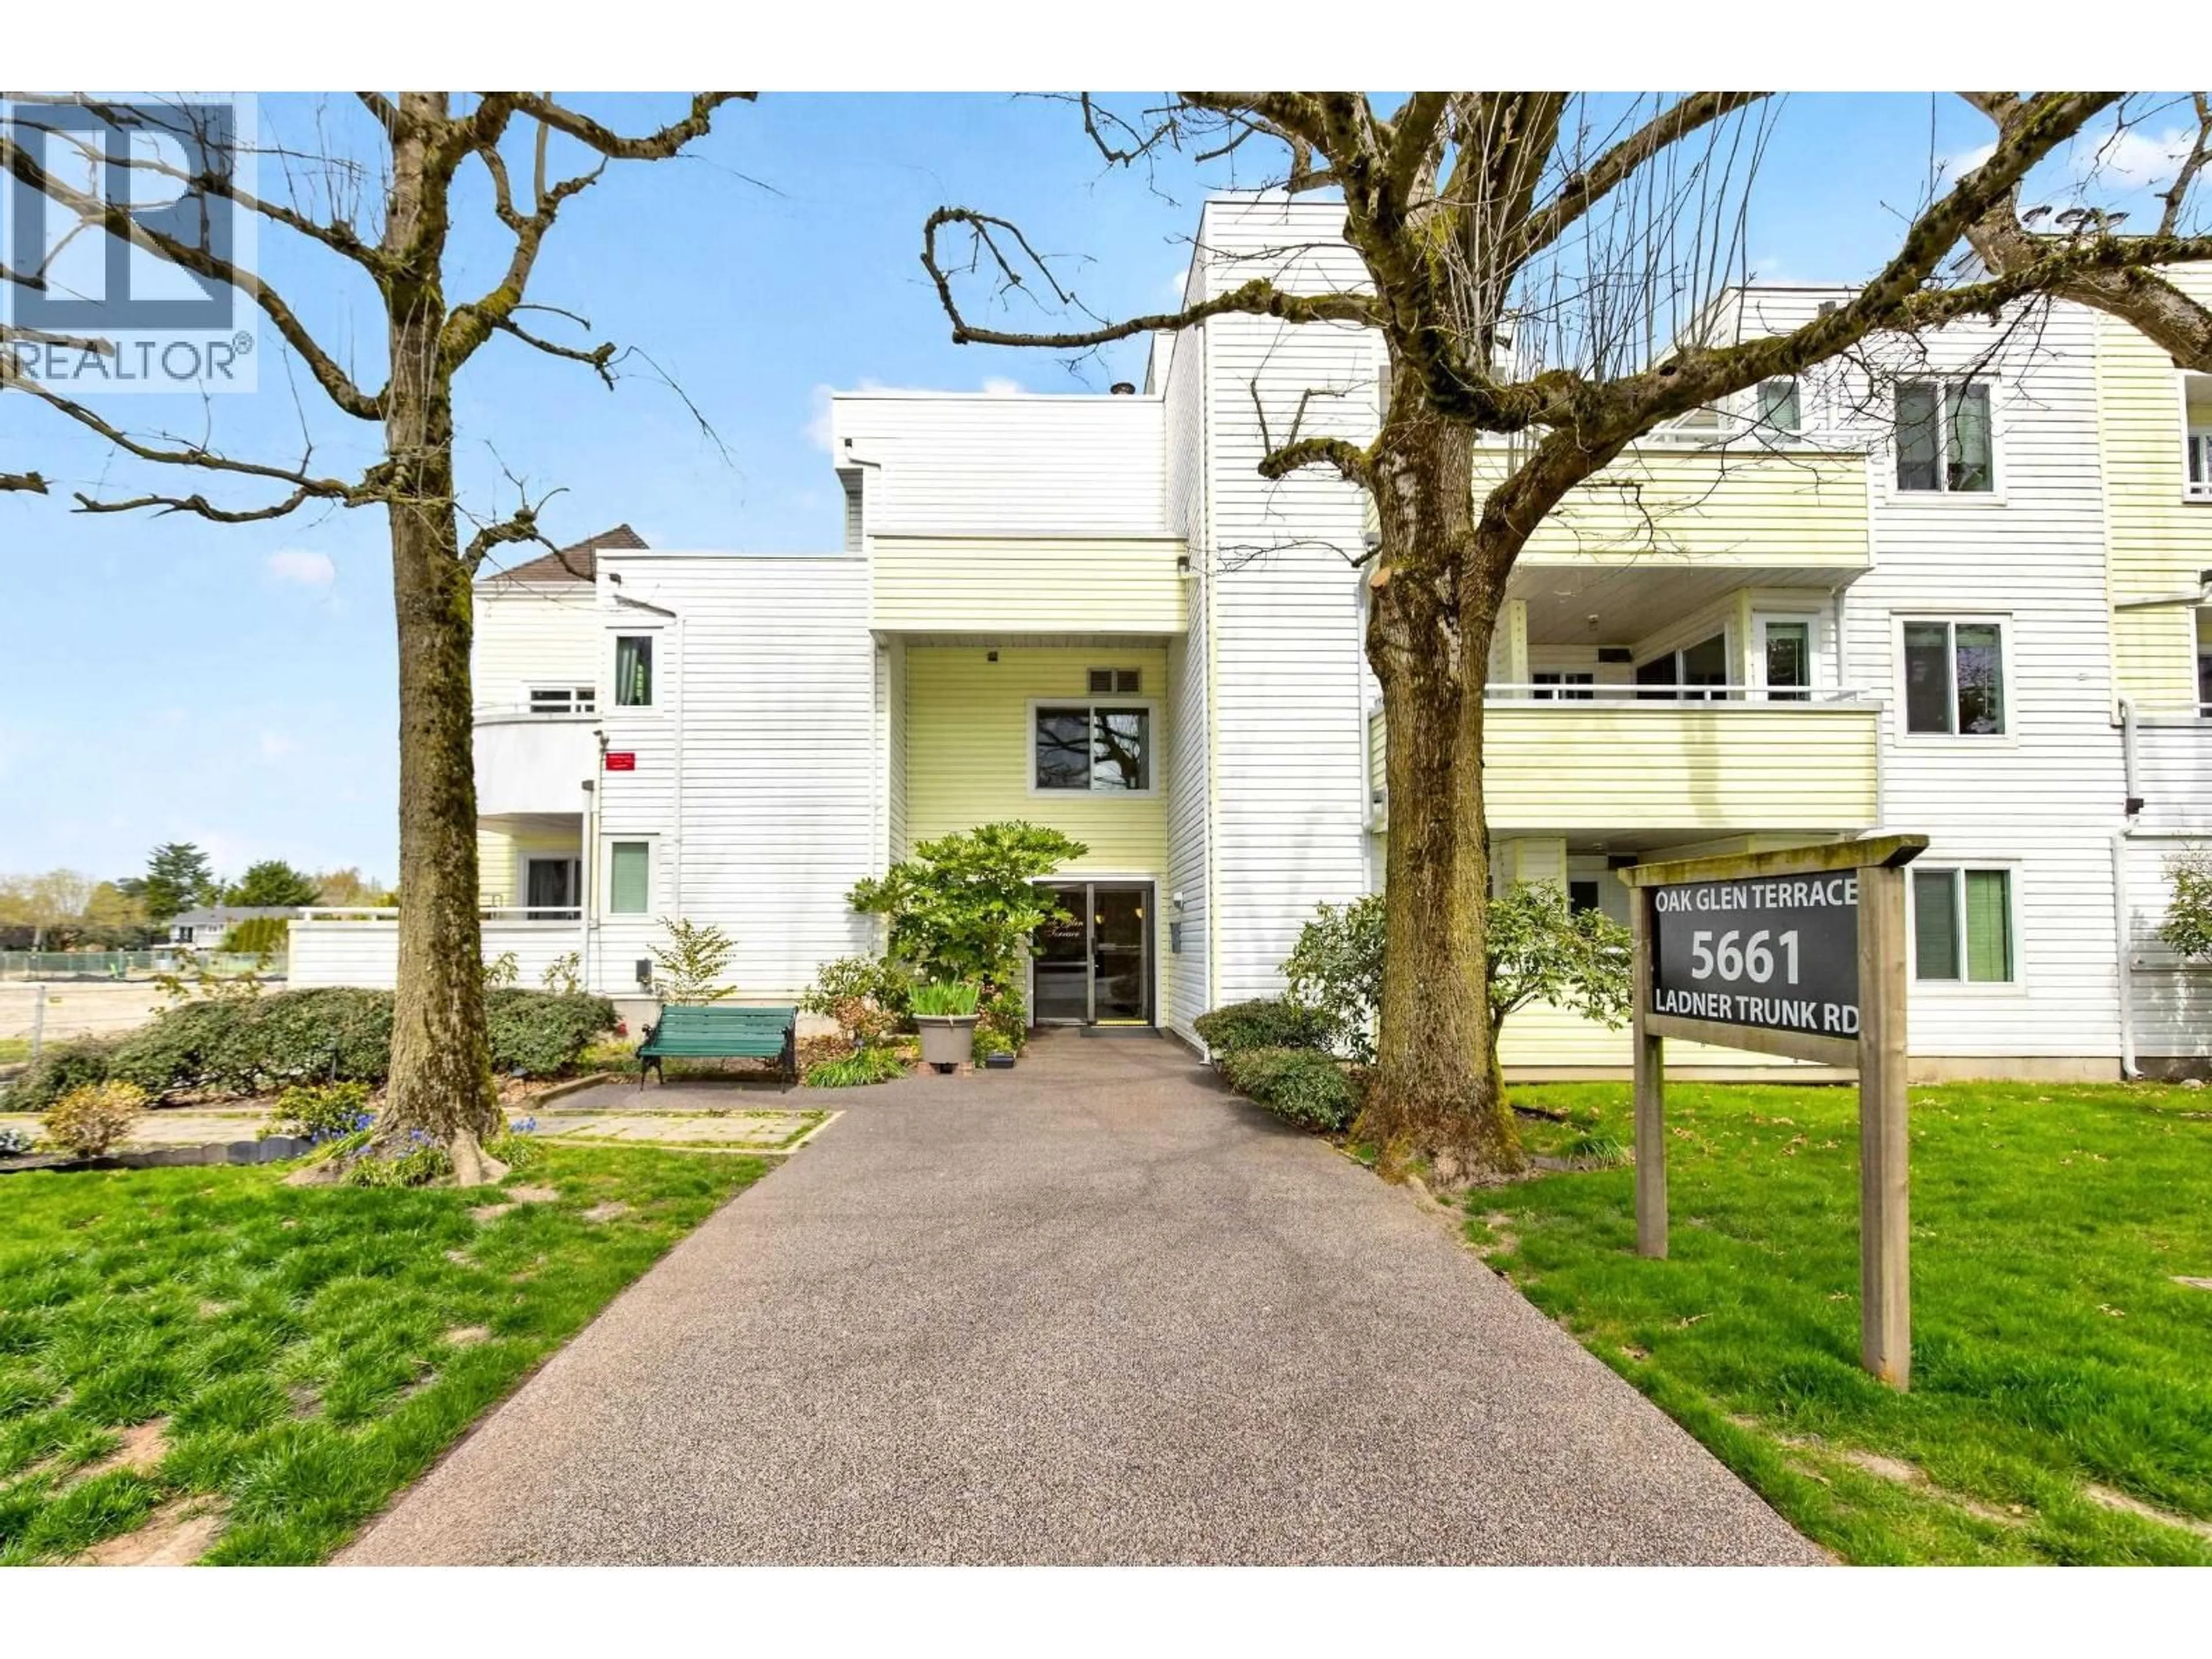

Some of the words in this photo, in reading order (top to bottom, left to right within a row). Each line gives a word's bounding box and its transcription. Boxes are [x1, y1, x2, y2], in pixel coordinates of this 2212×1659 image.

[1655, 889, 1692, 912] OAK
[1696, 885, 1747, 910] GLEN
[1751, 878, 1858, 908] TERRACE
[1691, 930, 1798, 984] 5661
[1656, 988, 1732, 1019] LADNER
[1735, 995, 1817, 1029] TRUNK
[1823, 1003, 1859, 1034] RD
